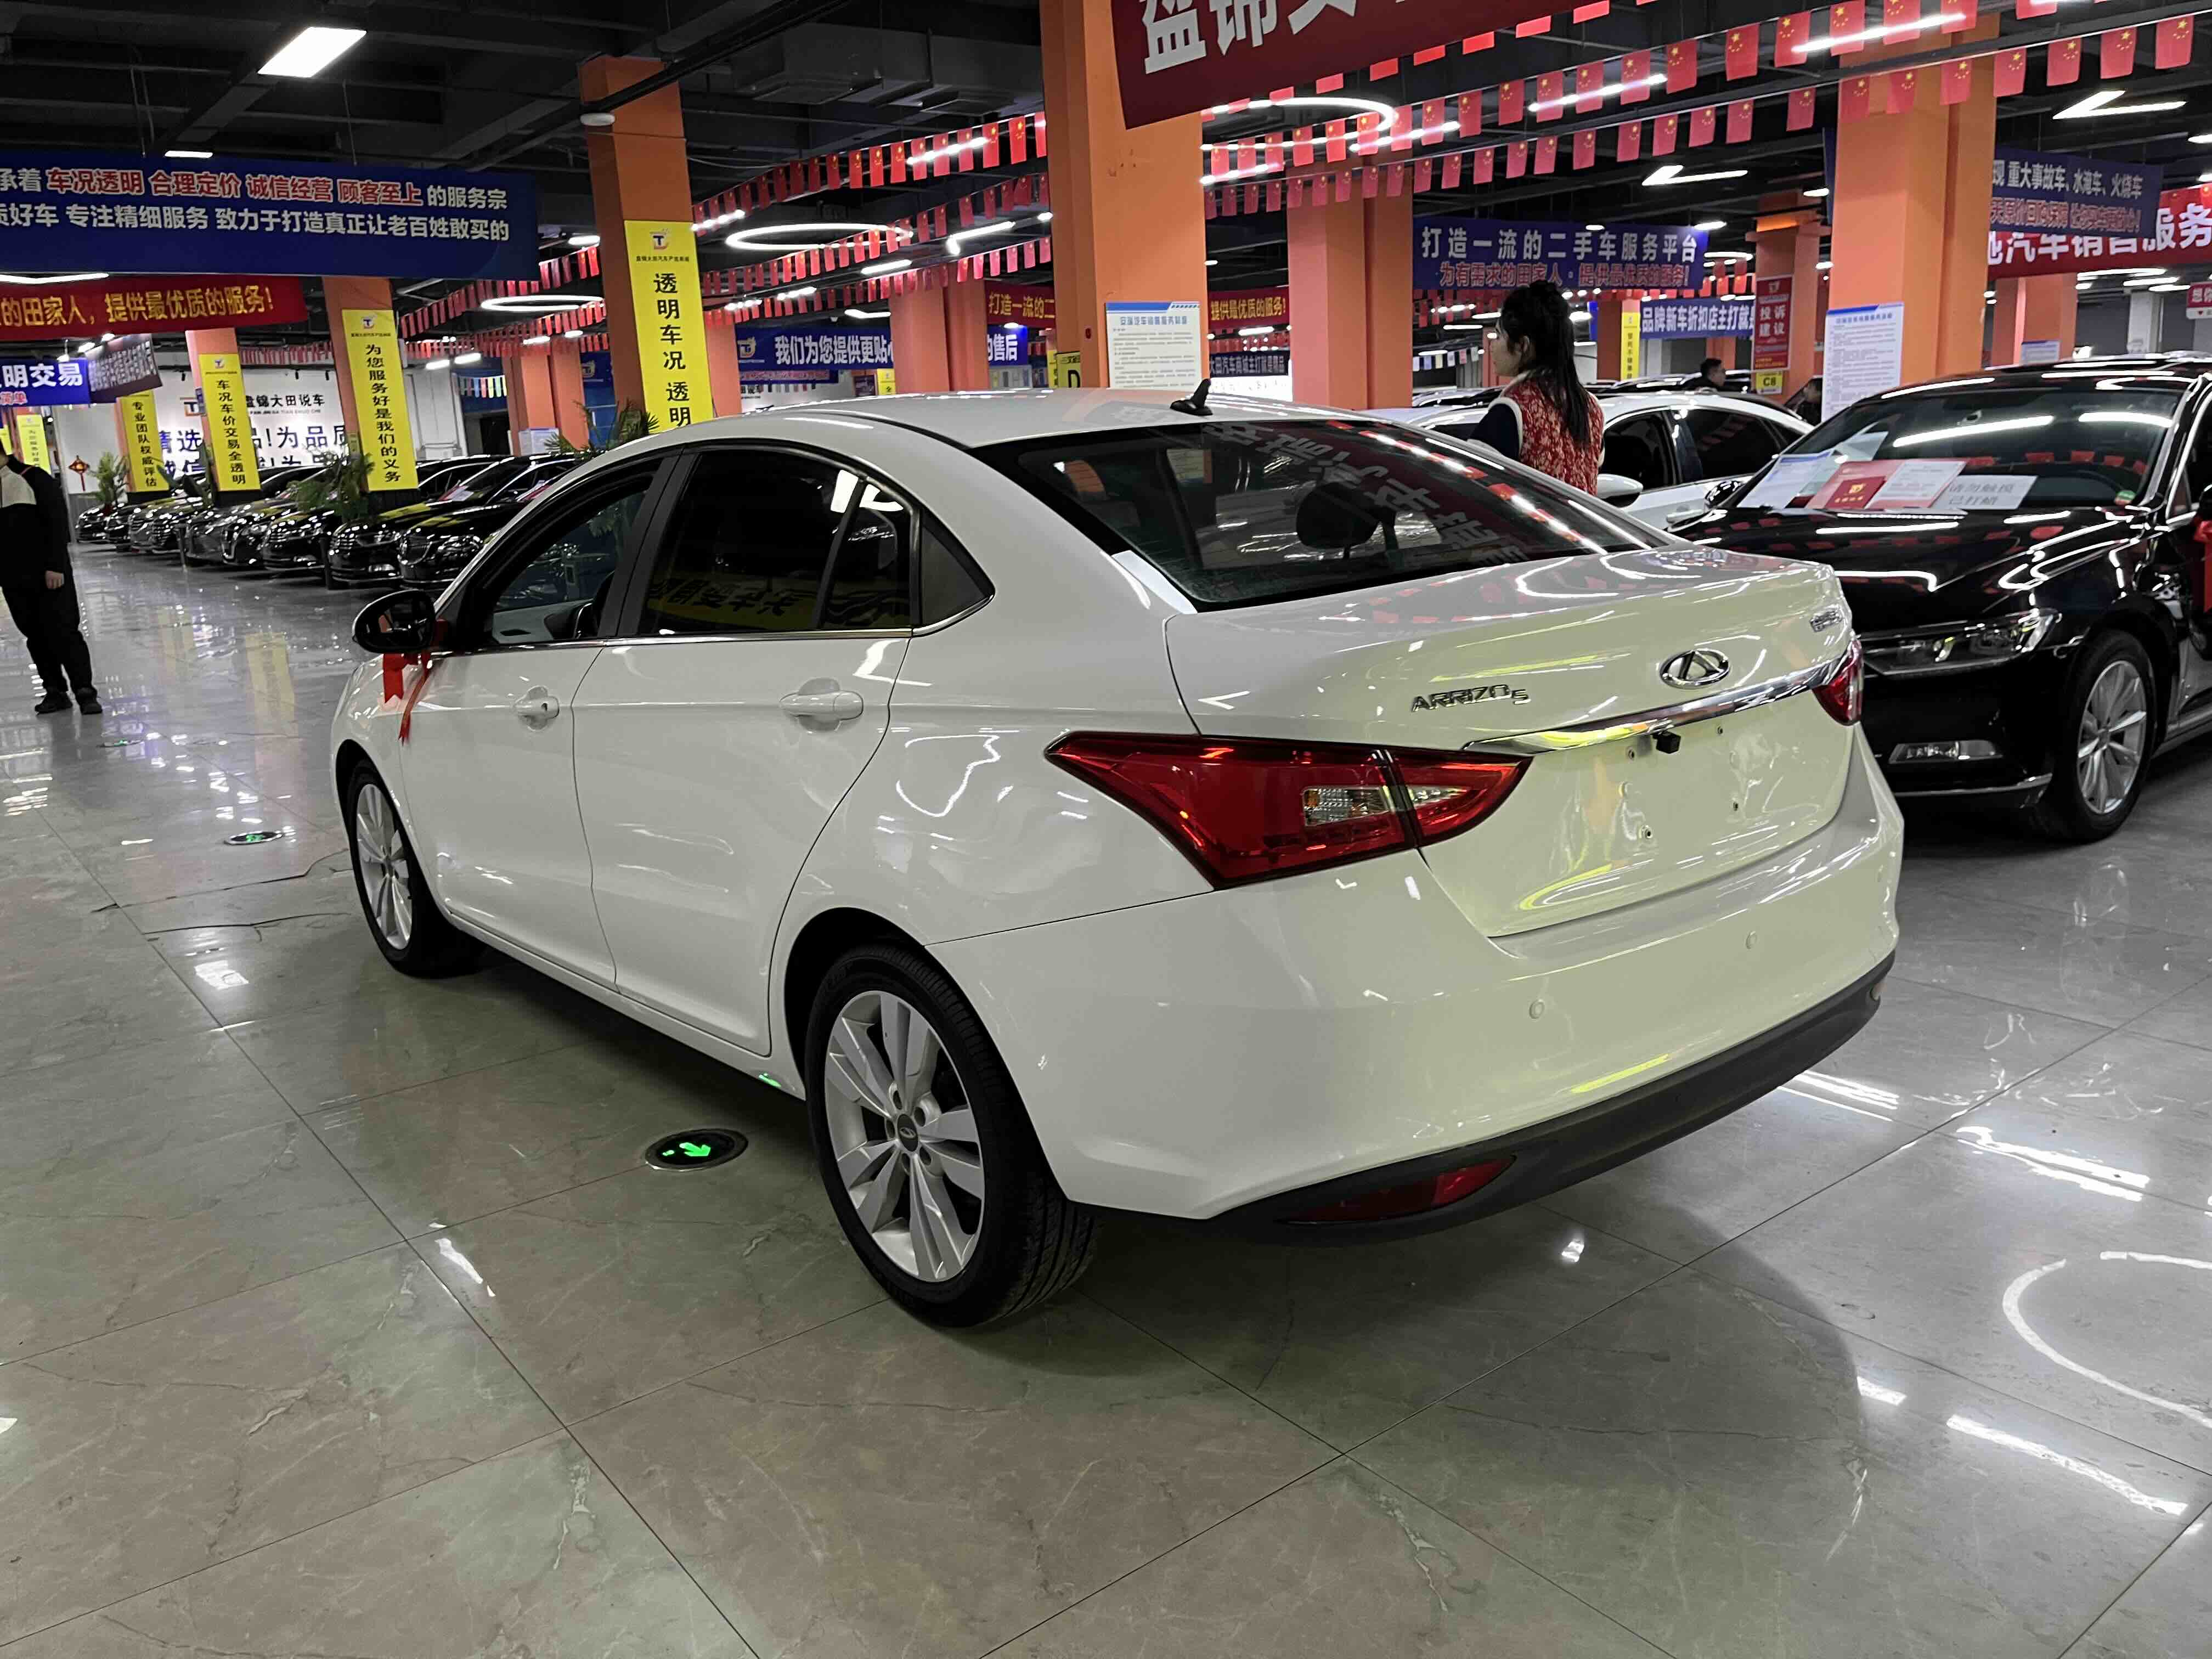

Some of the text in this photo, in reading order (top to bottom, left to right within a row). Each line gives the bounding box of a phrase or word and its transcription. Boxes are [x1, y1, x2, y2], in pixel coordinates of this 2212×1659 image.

[1144, 0, 1358, 74] 盘锦
[47, 167, 144, 195] 车况透明
[150, 171, 241, 198] 合理定价
[246, 174, 332, 202] 诚信经营
[338, 179, 423, 206] 顾客至上
[427, 185, 507, 210] 的服务宗
[66, 204, 208, 230] 专注精细服务
[215, 207, 509, 241] 致力于打造真正让老百姓敢买的
[1421, 225, 1697, 263] 打造一流的二手车服务平台
[989, 292, 1055, 320] 打造一流的二
[653, 273, 691, 427] 透明车况 透明
[774, 335, 894, 365] 我们为您提供更贴
[2, 363, 83, 387] 明交易
[217, 380, 246, 484] 车况车价交易全透明
[366, 344, 401, 482] 为您服务好是我们的义务
[132, 402, 157, 487] 专业团队权威评估
[1411, 684, 1511, 712] ARRIZO
